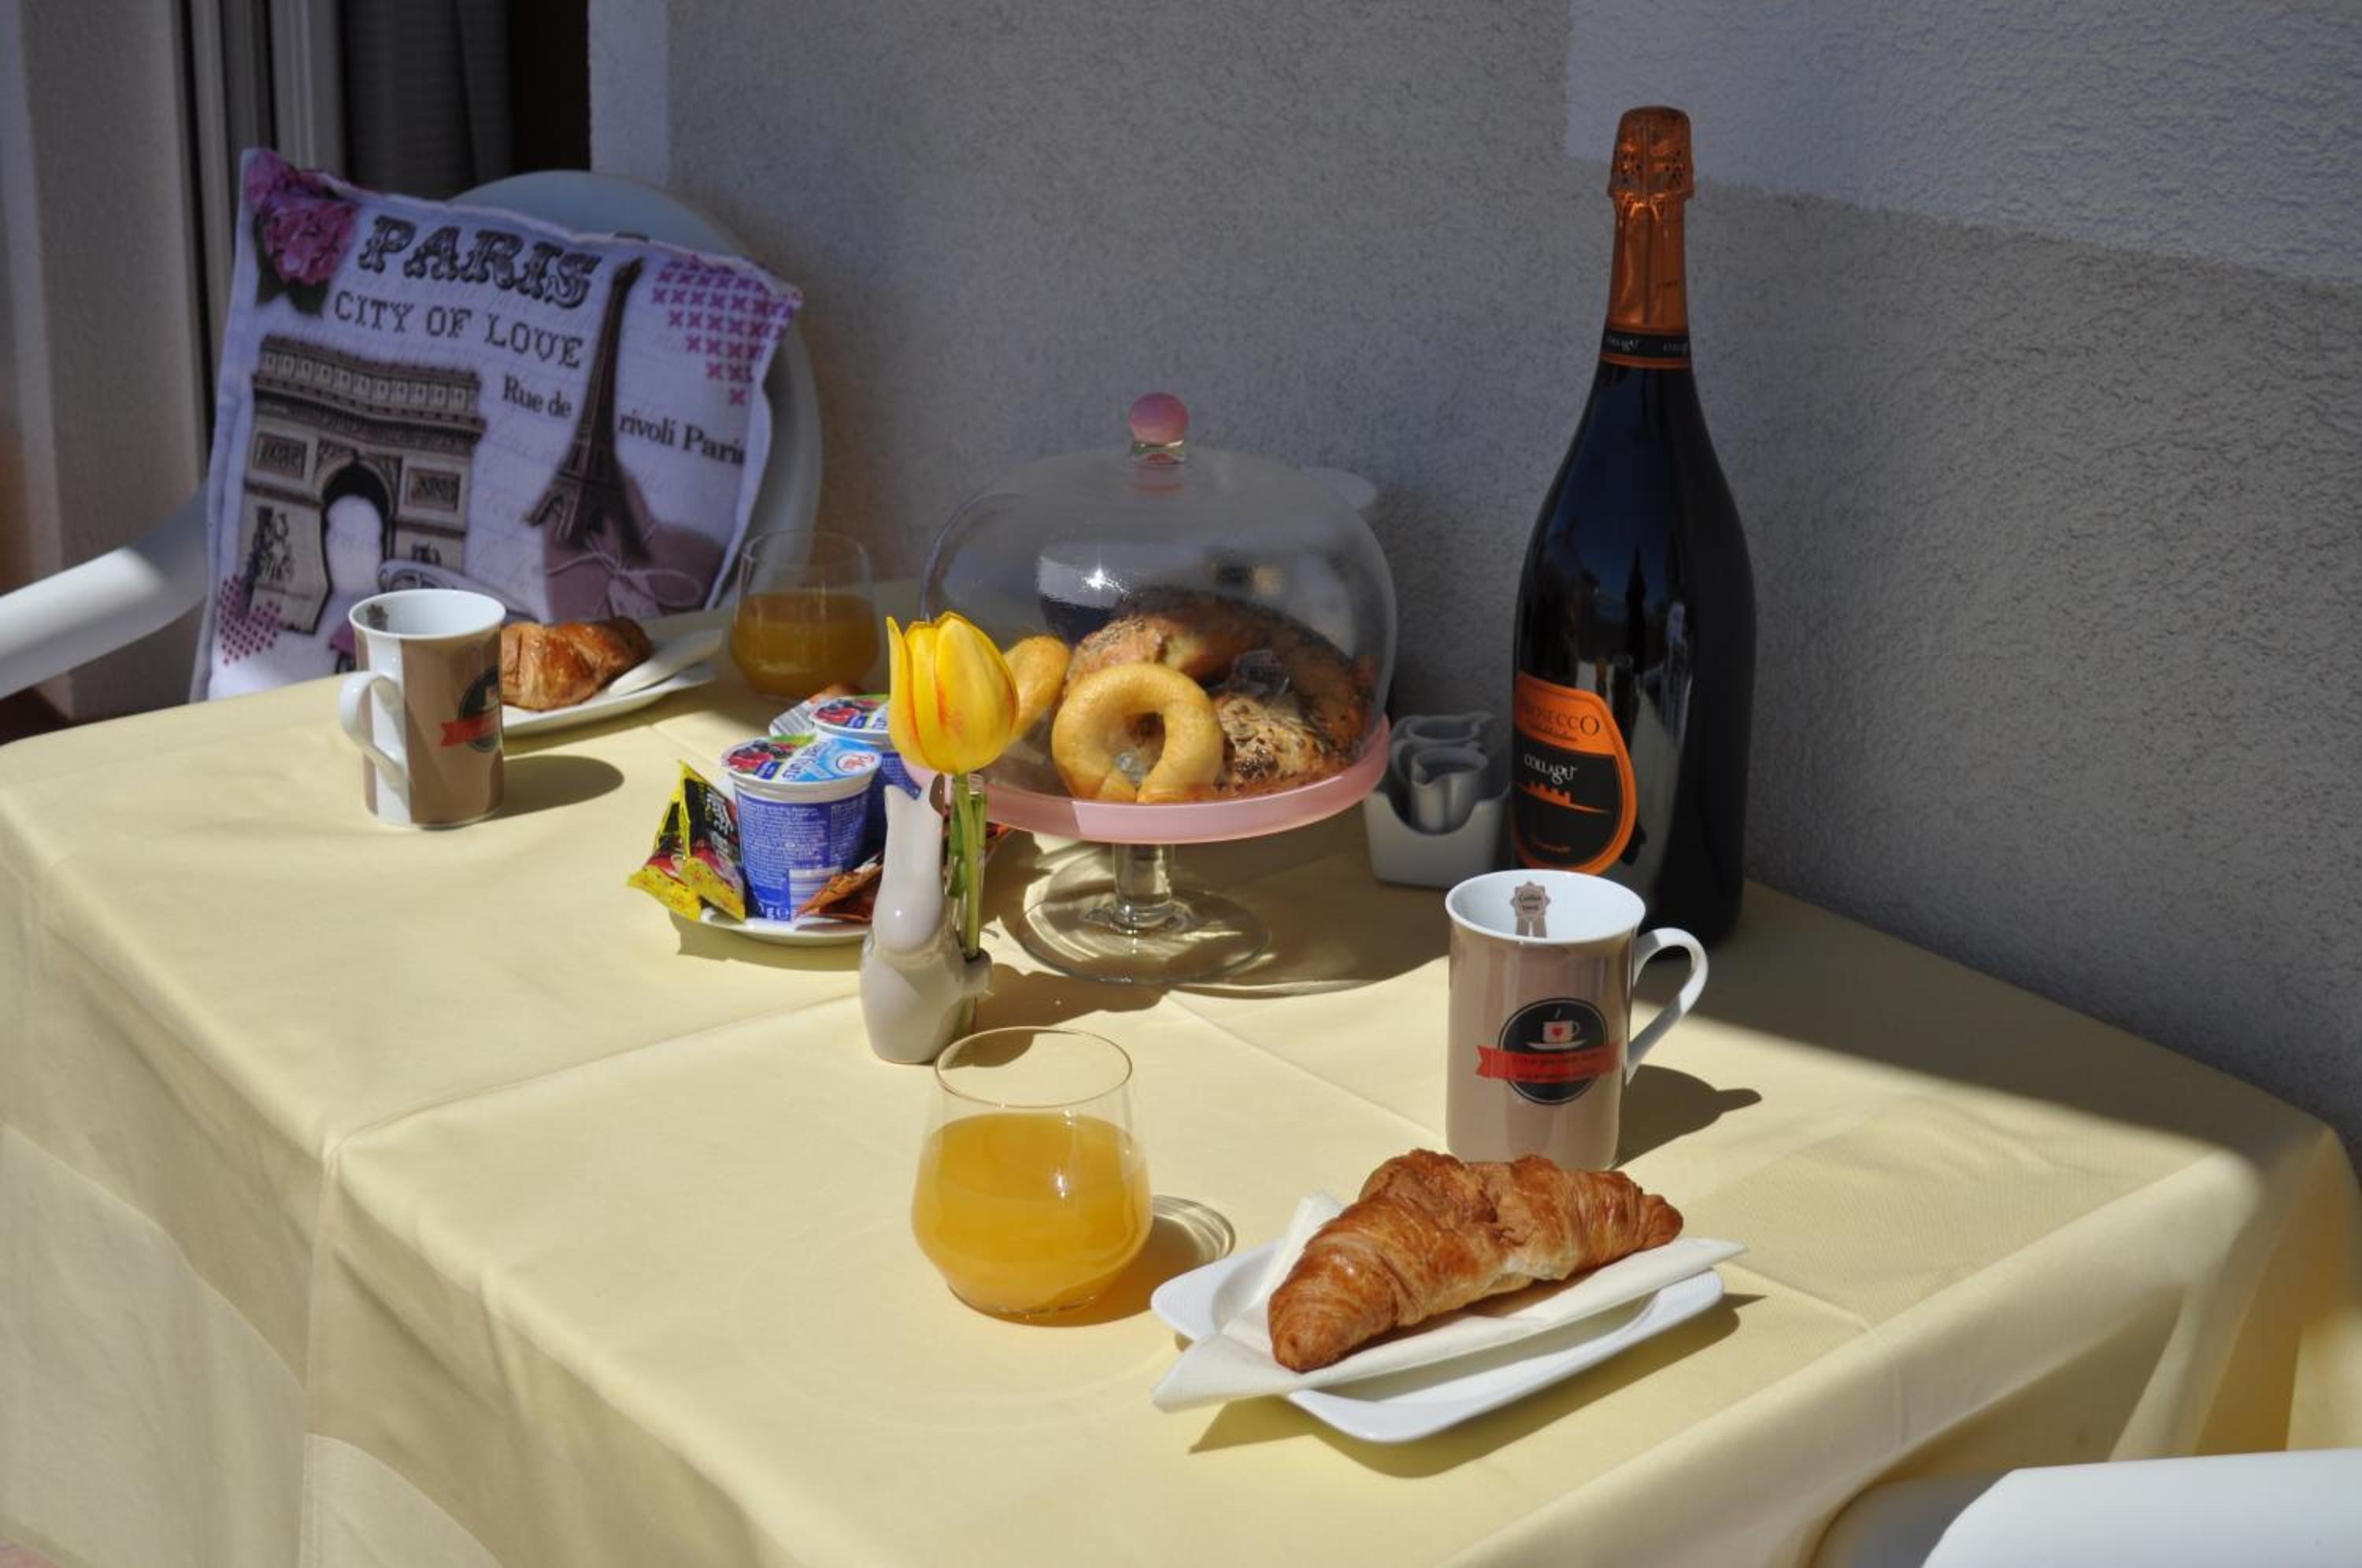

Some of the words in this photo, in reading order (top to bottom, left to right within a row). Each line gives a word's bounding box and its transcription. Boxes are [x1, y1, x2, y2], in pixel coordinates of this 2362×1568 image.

[358, 215, 602, 309] PARIS
[334, 290, 414, 333] CITY
[426, 306, 472, 338] OF
[484, 313, 583, 368] LOVE
[502, 375, 543, 413] Rue
[548, 390, 572, 419] de
[618, 408, 677, 446] rivoli
